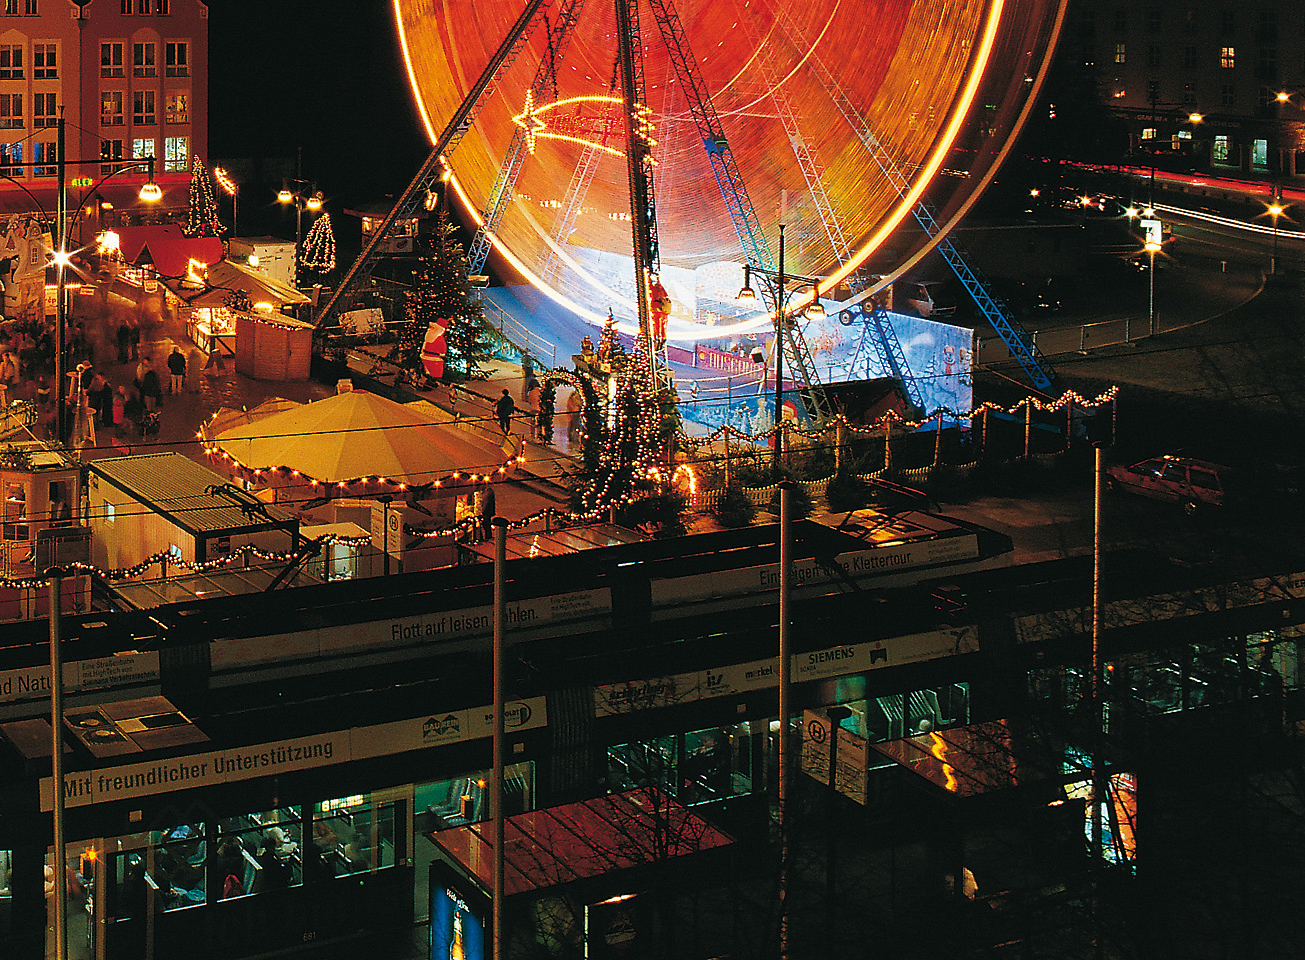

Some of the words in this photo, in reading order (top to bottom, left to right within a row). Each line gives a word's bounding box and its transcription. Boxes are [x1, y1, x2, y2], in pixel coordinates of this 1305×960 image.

[391, 623, 422, 640] Flott
[425, 616, 445, 635] auf
[450, 614, 488, 631] leisen
[808, 647, 855, 665] SIEMENS
[63, 777, 92, 797] Mit
[98, 762, 208, 793] freundlicher
[214, 742, 334, 774] Unterstützung
